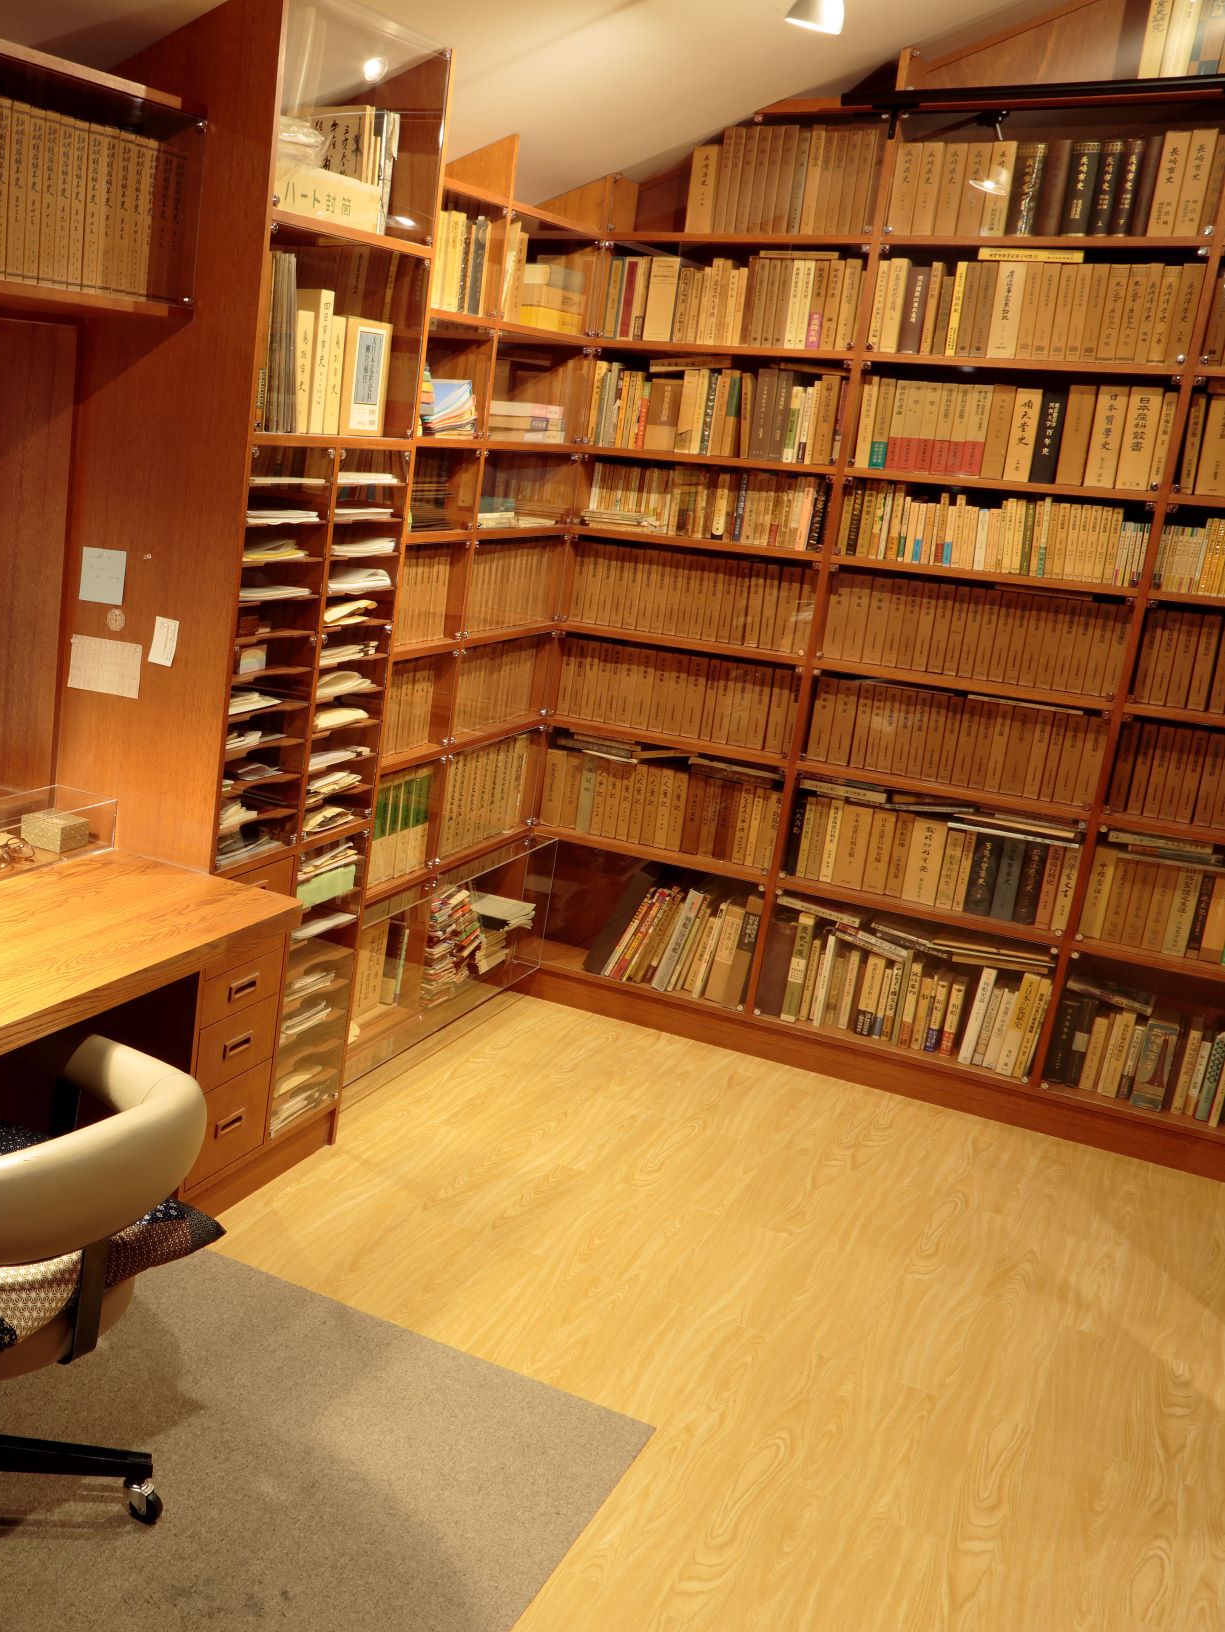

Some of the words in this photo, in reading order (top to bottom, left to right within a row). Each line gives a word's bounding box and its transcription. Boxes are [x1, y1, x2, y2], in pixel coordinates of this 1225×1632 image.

[1165, 146, 1180, 184] 長崎市史
[1191, 143, 1207, 182] 長崎市史
[284, 181, 352, 218] ハート封筒
[1016, 399, 1034, 446] 順天堂史
